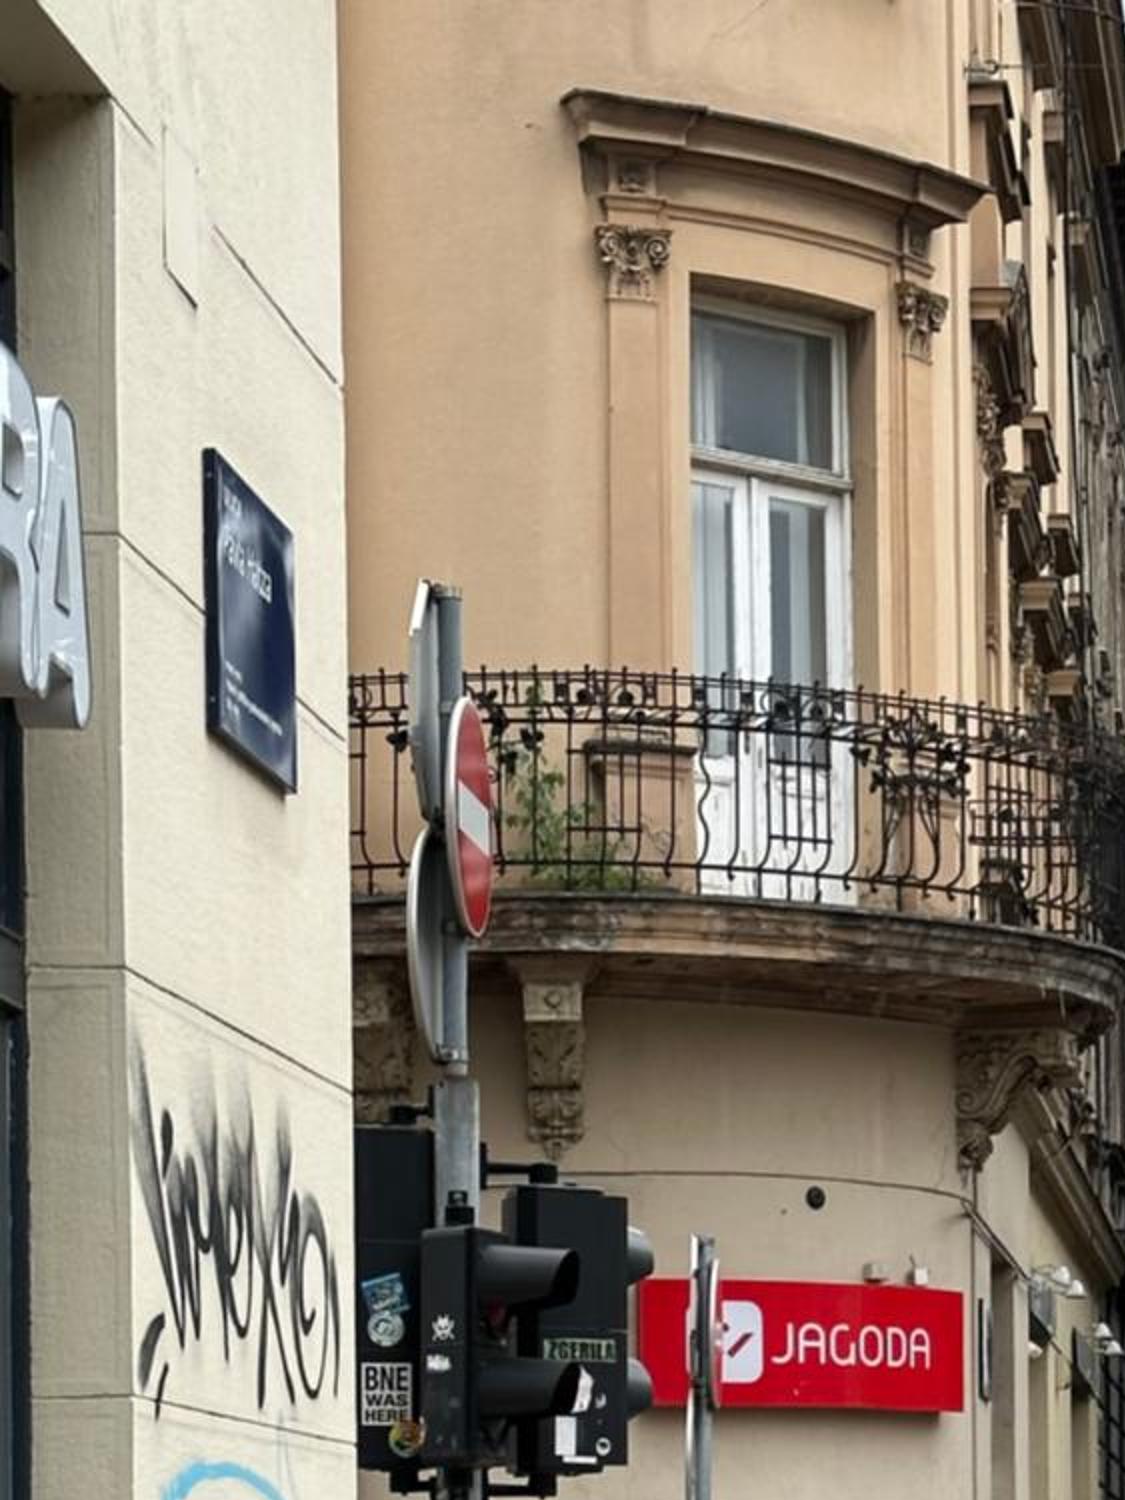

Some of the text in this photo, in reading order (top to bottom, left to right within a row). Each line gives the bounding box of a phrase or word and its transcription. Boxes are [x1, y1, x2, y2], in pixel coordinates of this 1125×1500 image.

[770, 1321, 932, 1371] JAGODA
[365, 1366, 409, 1391] BNE
[365, 1394, 409, 1407] WAS
